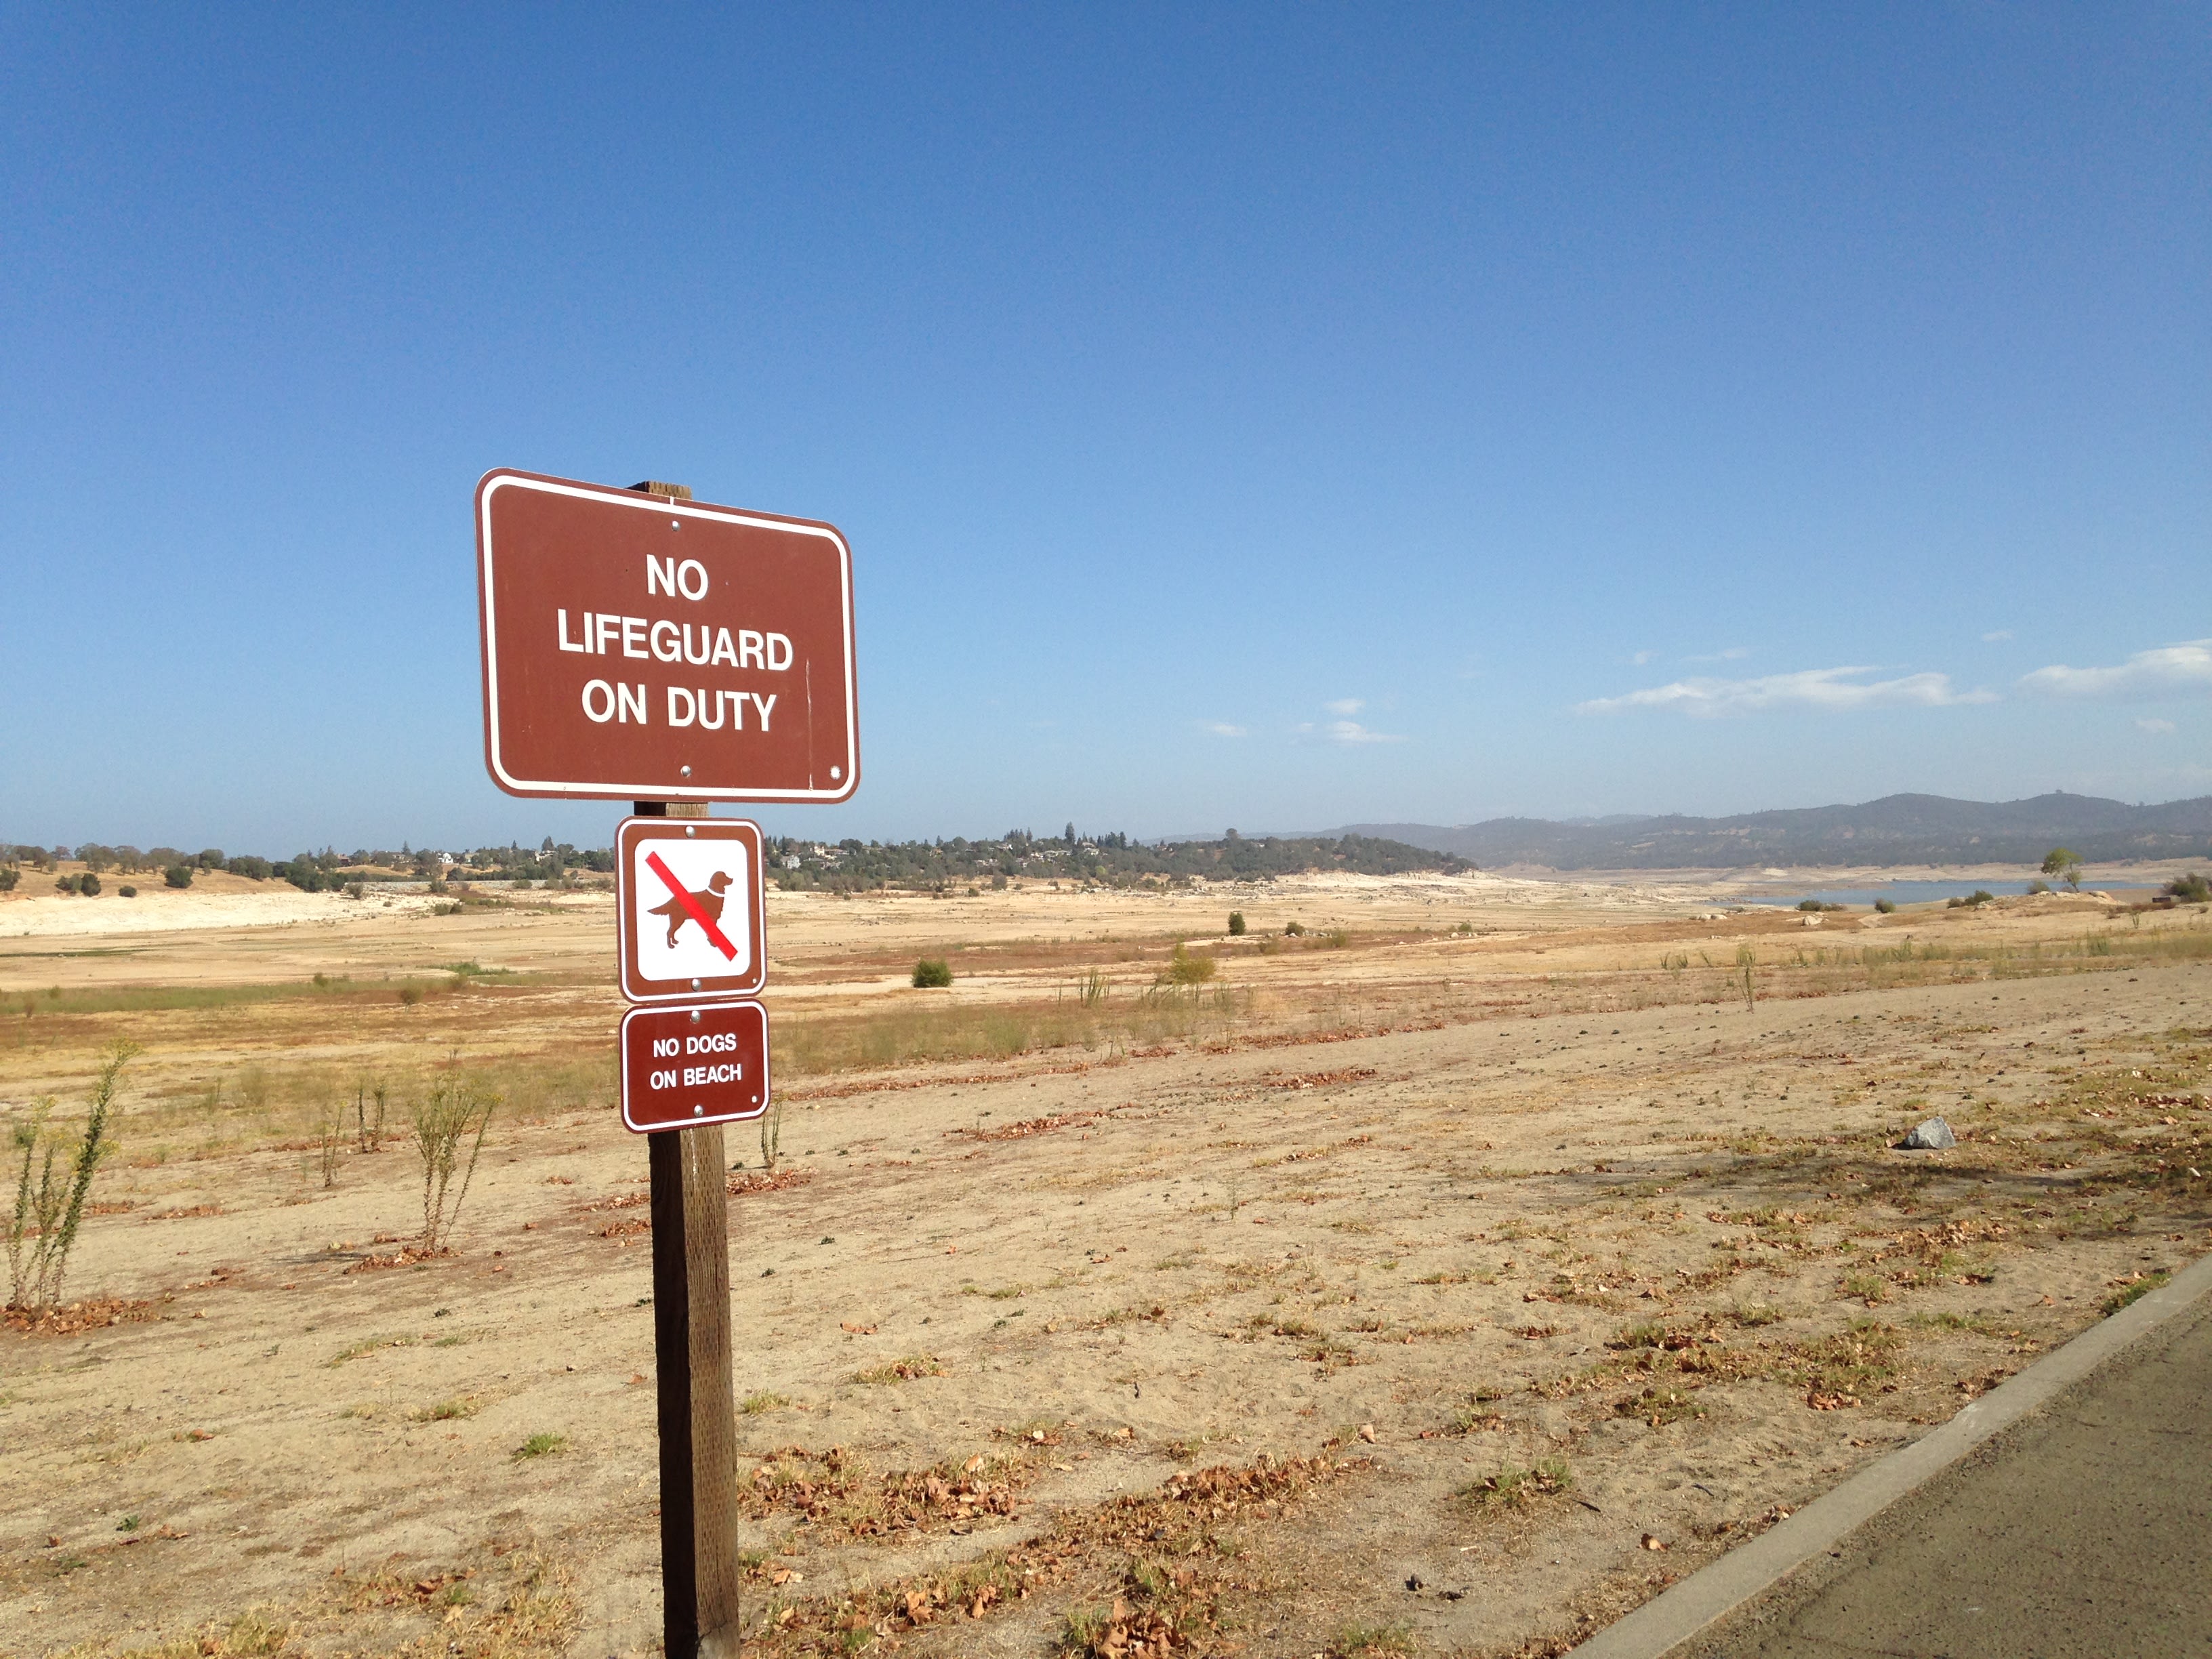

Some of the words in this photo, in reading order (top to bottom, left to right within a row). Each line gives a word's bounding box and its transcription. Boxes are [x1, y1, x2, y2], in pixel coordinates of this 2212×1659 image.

[646, 554, 709, 601] NO
[557, 609, 794, 672] LIFEGUARD
[581, 678, 647, 724] ON
[667, 686, 777, 732] DUTY
[653, 1038, 680, 1058] NO
[686, 1033, 737, 1054] DOGS
[650, 1069, 676, 1090] ON
[683, 1063, 742, 1086] BEACH
